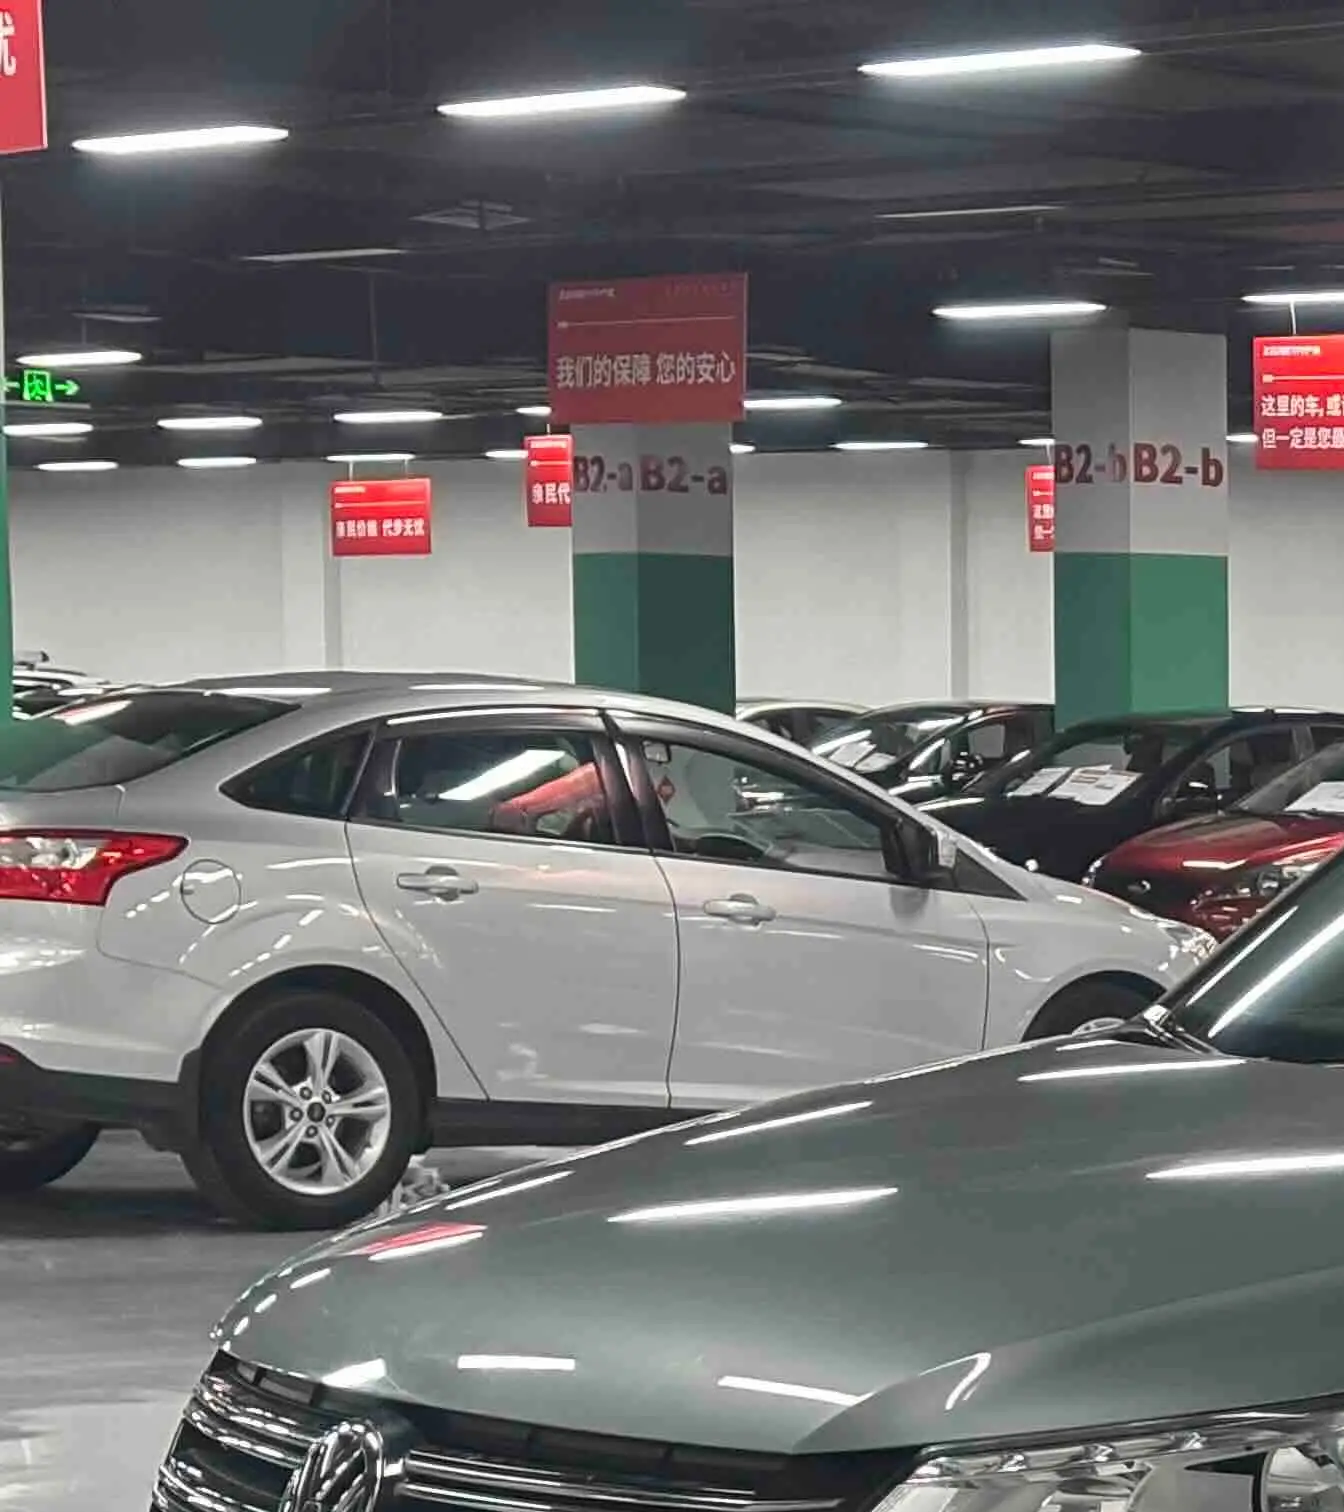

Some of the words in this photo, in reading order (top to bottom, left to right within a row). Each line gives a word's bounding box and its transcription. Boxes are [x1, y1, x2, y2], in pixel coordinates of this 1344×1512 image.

[556, 353, 651, 388] 我们的保障
[656, 349, 736, 385] 您的安心
[639, 455, 728, 495] B2-a
[1133, 442, 1224, 487] B2-b
